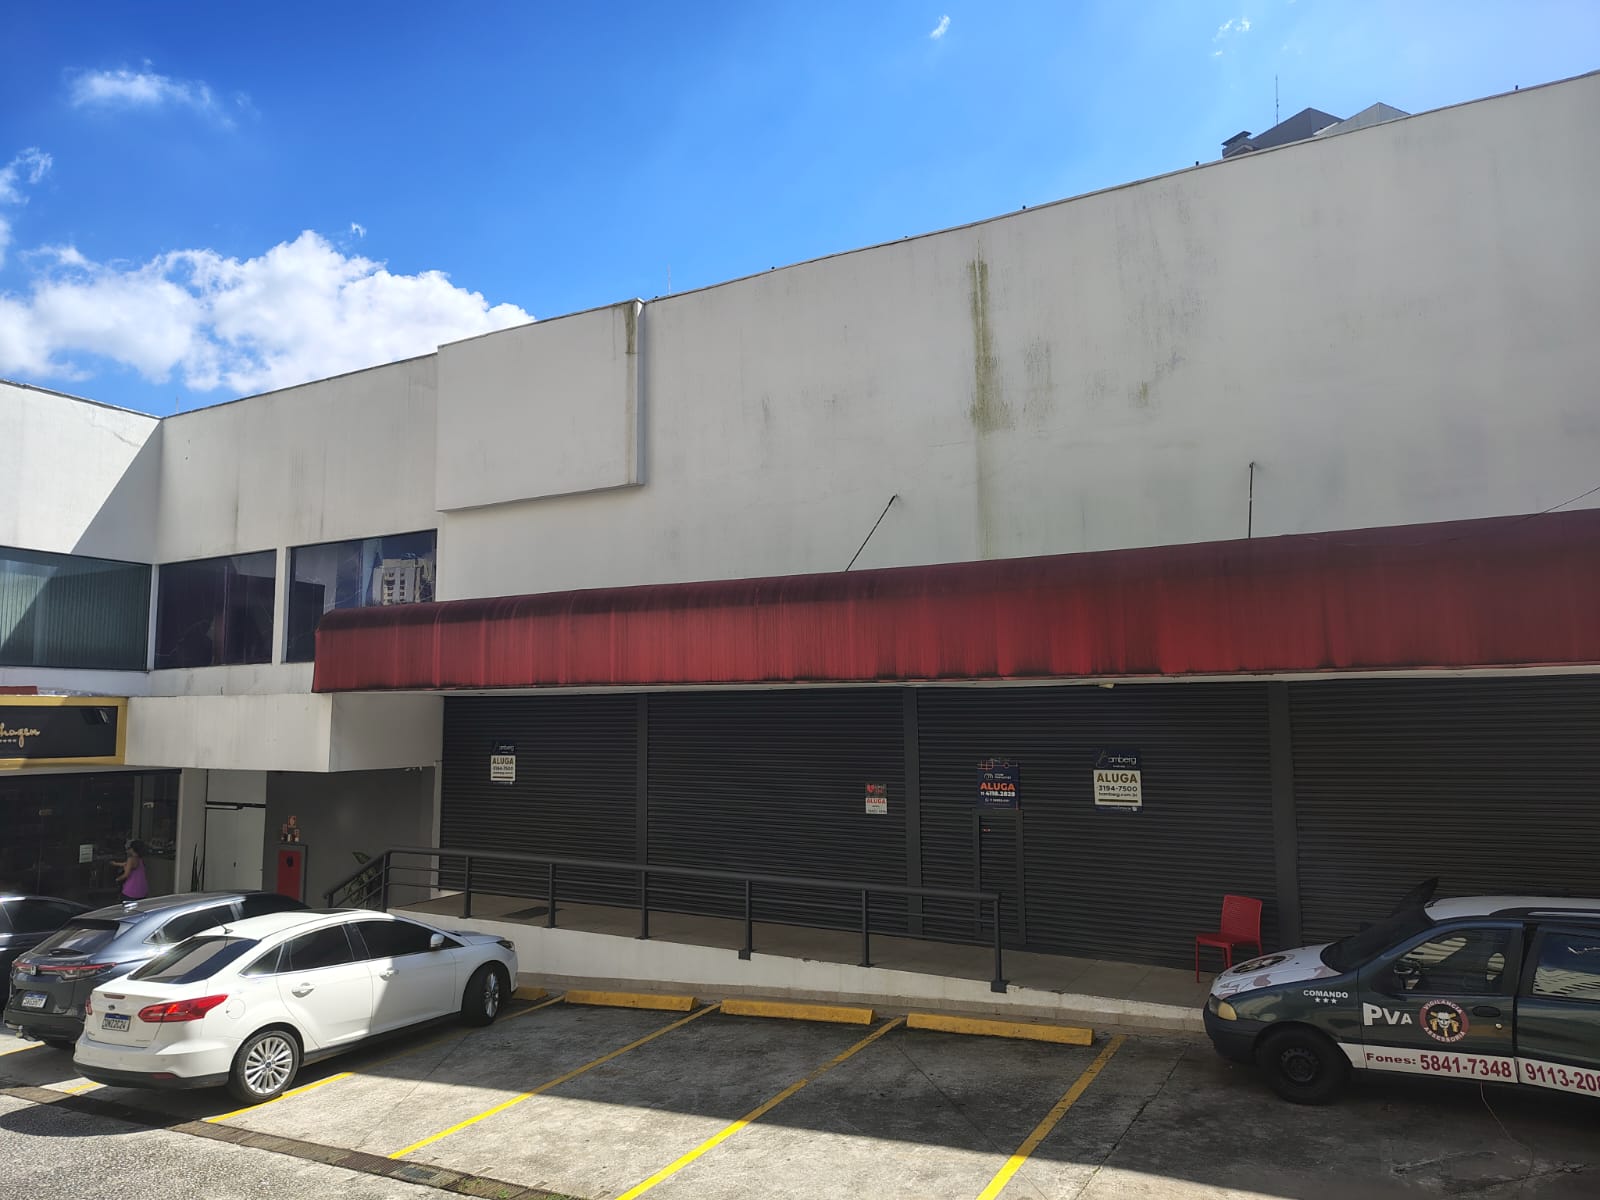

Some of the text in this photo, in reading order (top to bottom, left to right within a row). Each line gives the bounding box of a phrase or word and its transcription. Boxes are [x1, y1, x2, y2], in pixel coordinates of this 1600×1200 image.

[492, 757, 513, 765] ALUGA
[1096, 773, 1138, 784] ALUGA
[980, 782, 1016, 791] ALUGA
[1098, 784, 1138, 792] 3194-7500
[1303, 990, 1349, 999] COMANDO
[1423, 999, 1463, 1014] VIGILANCIA
[1362, 1002, 1413, 1026] PVA
[1366, 1052, 1600, 1092] Fones: 5841-7348 9113-20
